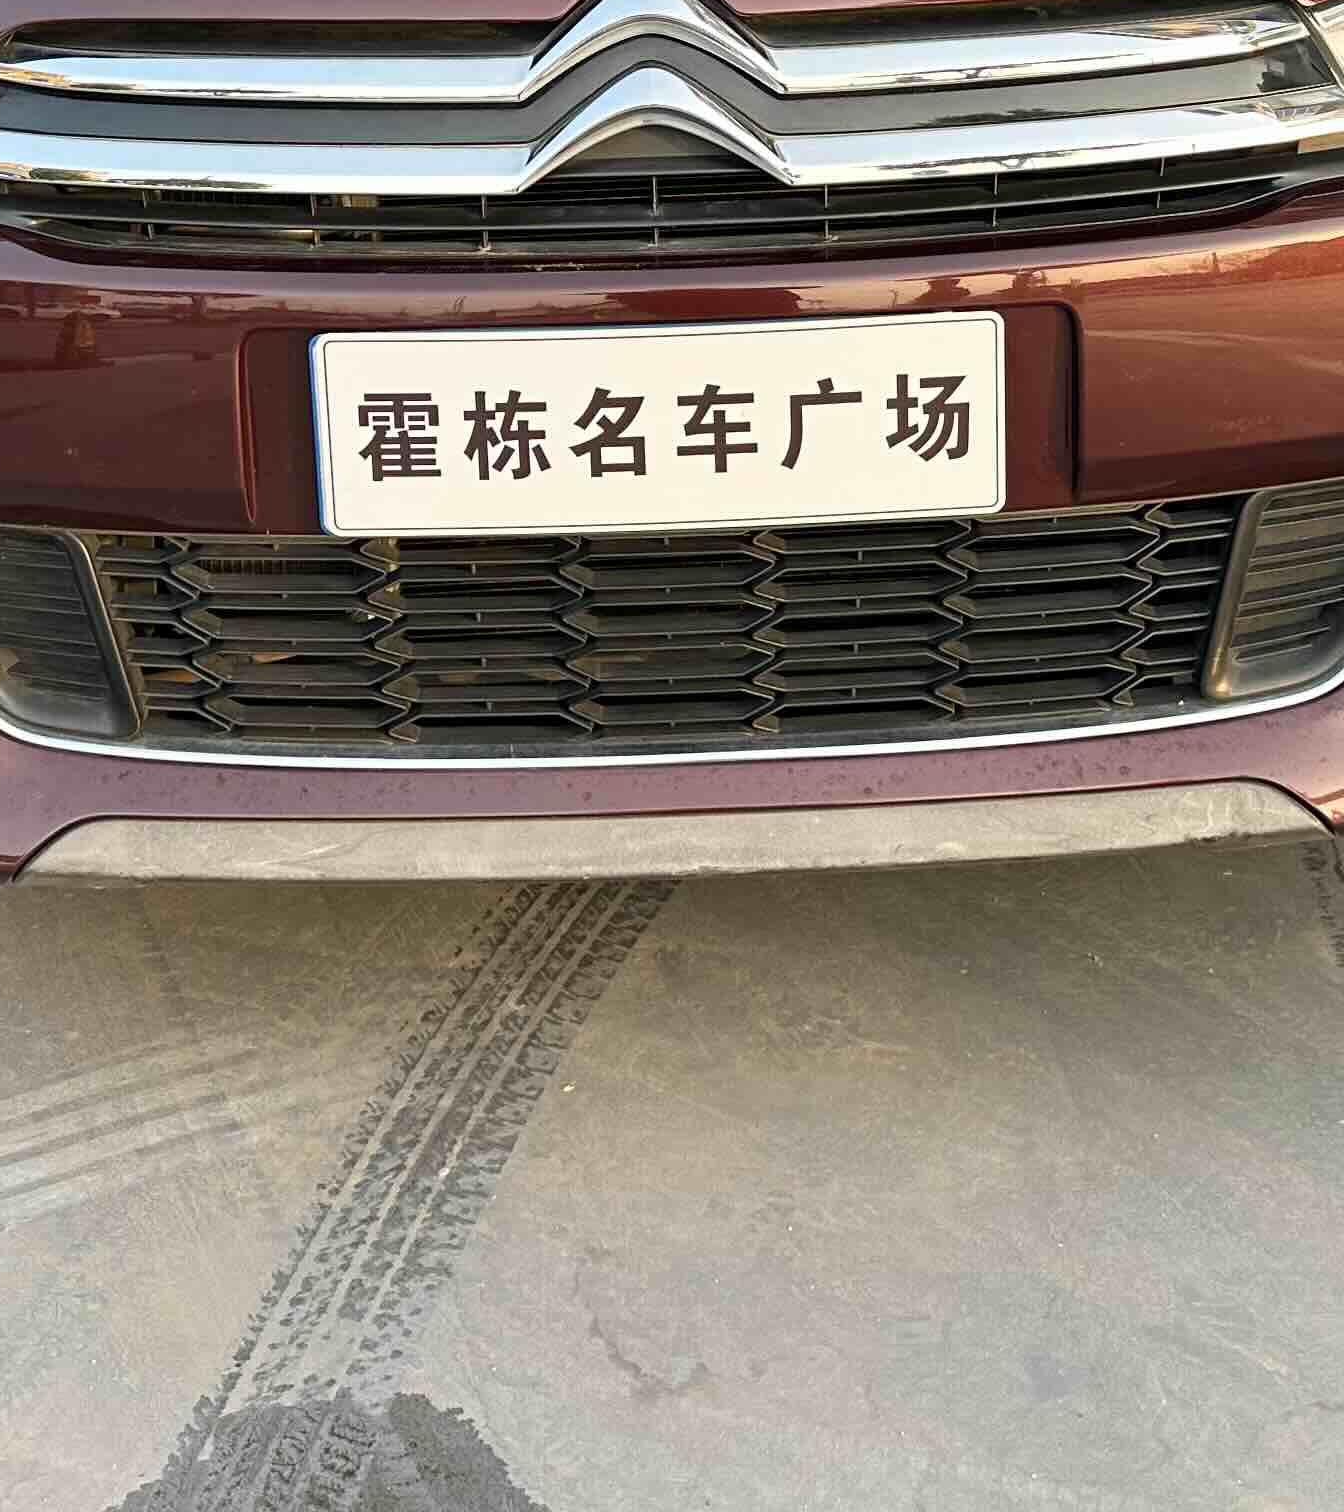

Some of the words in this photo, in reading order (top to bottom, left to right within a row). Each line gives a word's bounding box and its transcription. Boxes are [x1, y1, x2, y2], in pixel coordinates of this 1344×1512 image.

[357, 373, 971, 482] 霍栋名车广场
